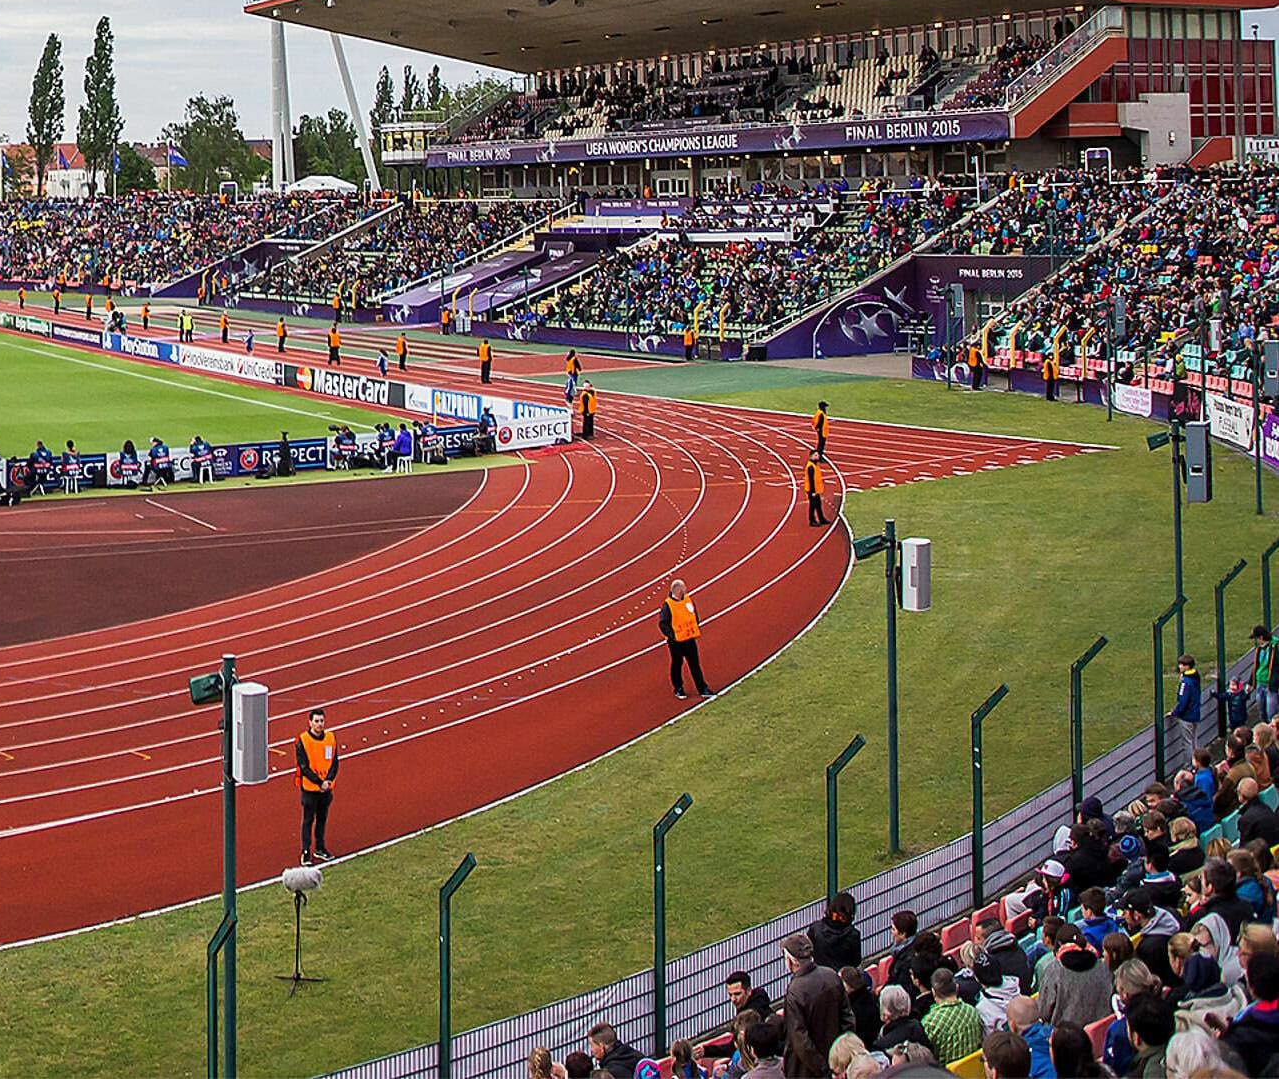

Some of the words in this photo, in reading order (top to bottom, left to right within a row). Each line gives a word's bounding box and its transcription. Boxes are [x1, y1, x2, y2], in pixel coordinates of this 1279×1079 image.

[845, 124, 882, 142] FINAL
[886, 122, 928, 140] BERLIN
[931, 119, 962, 137] 2015
[447, 150, 467, 162] FINAL
[469, 149, 494, 161] BERLIN
[495, 147, 511, 160] 2015
[585, 141, 609, 156] UEFA
[609, 138, 648, 155] WOMEN'S
[649, 136, 701, 153] CHAMPIONS
[702, 133, 738, 150] LEAGUE
[959, 268, 980, 279] FINAL
[982, 268, 1006, 279] BERLIN
[1007, 268, 1024, 279] 2015
[120, 334, 159, 358] PlayStation
[314, 369, 389, 405] MasterCard
[517, 422, 569, 440] RESPECT
